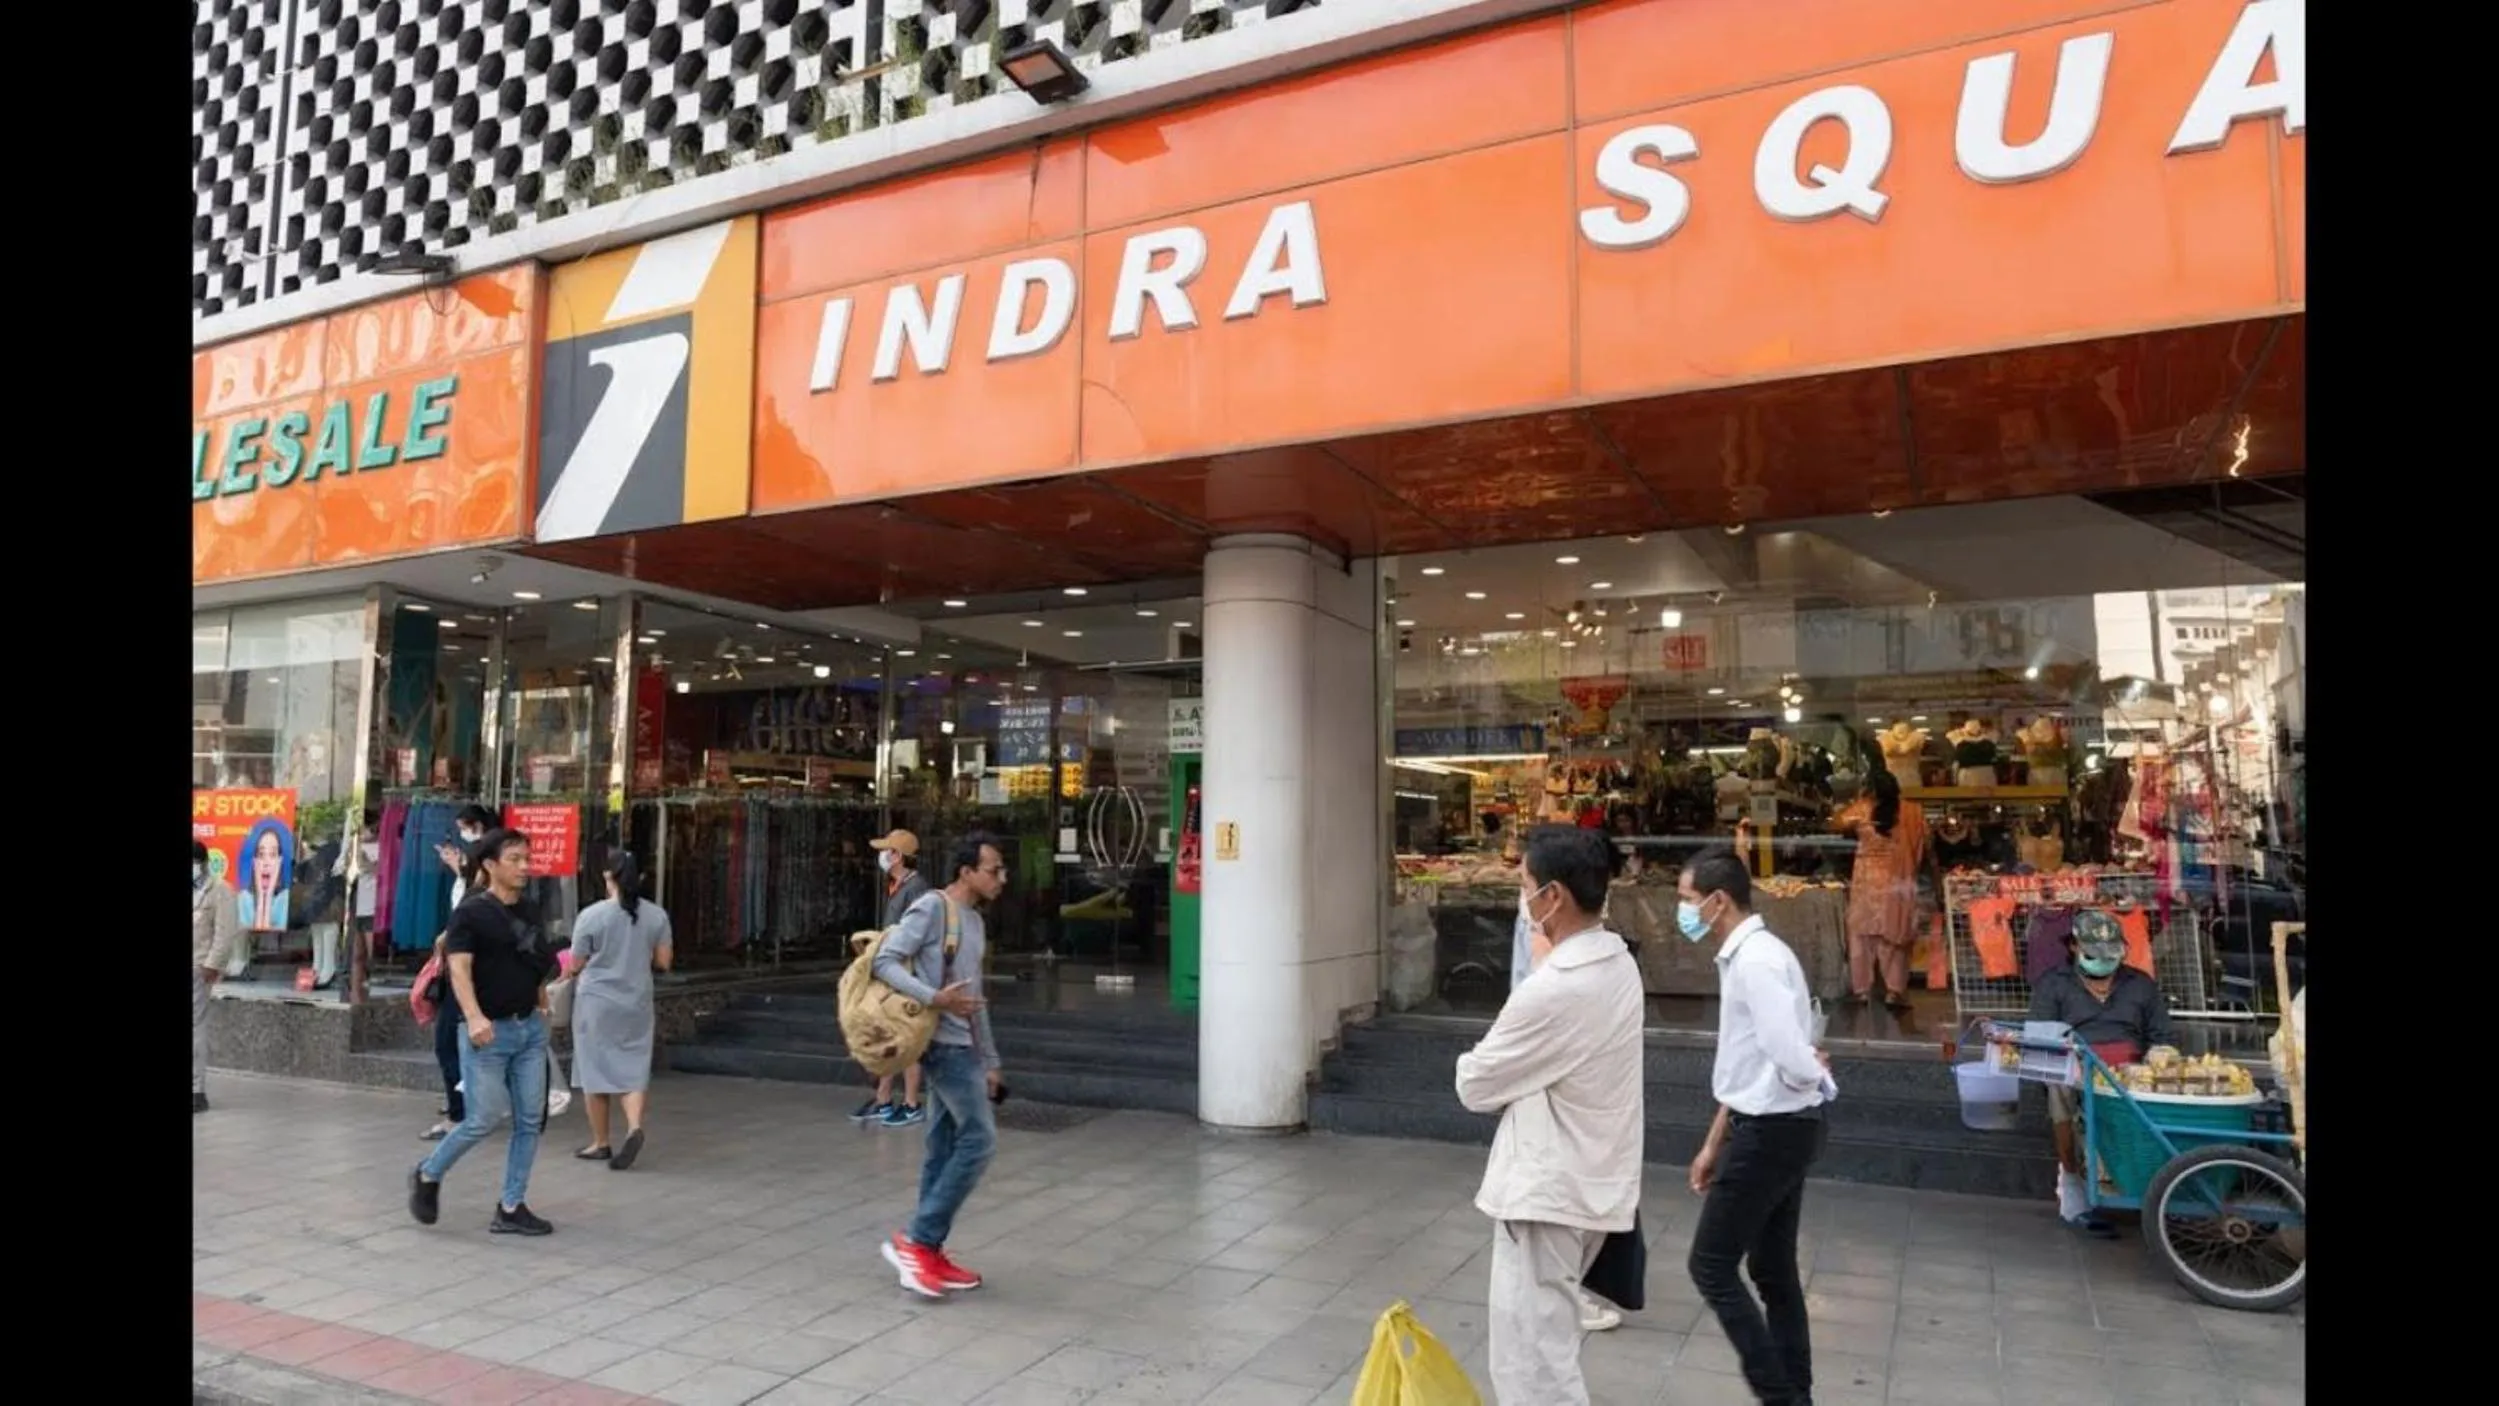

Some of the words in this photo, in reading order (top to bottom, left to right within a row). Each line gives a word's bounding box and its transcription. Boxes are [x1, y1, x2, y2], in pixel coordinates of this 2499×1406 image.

[810, 200, 1327, 395] INDRA
[1580, 0, 2305, 250] SQUA
[193, 372, 458, 500] LESALE
[214, 794, 287, 817] STOCK
